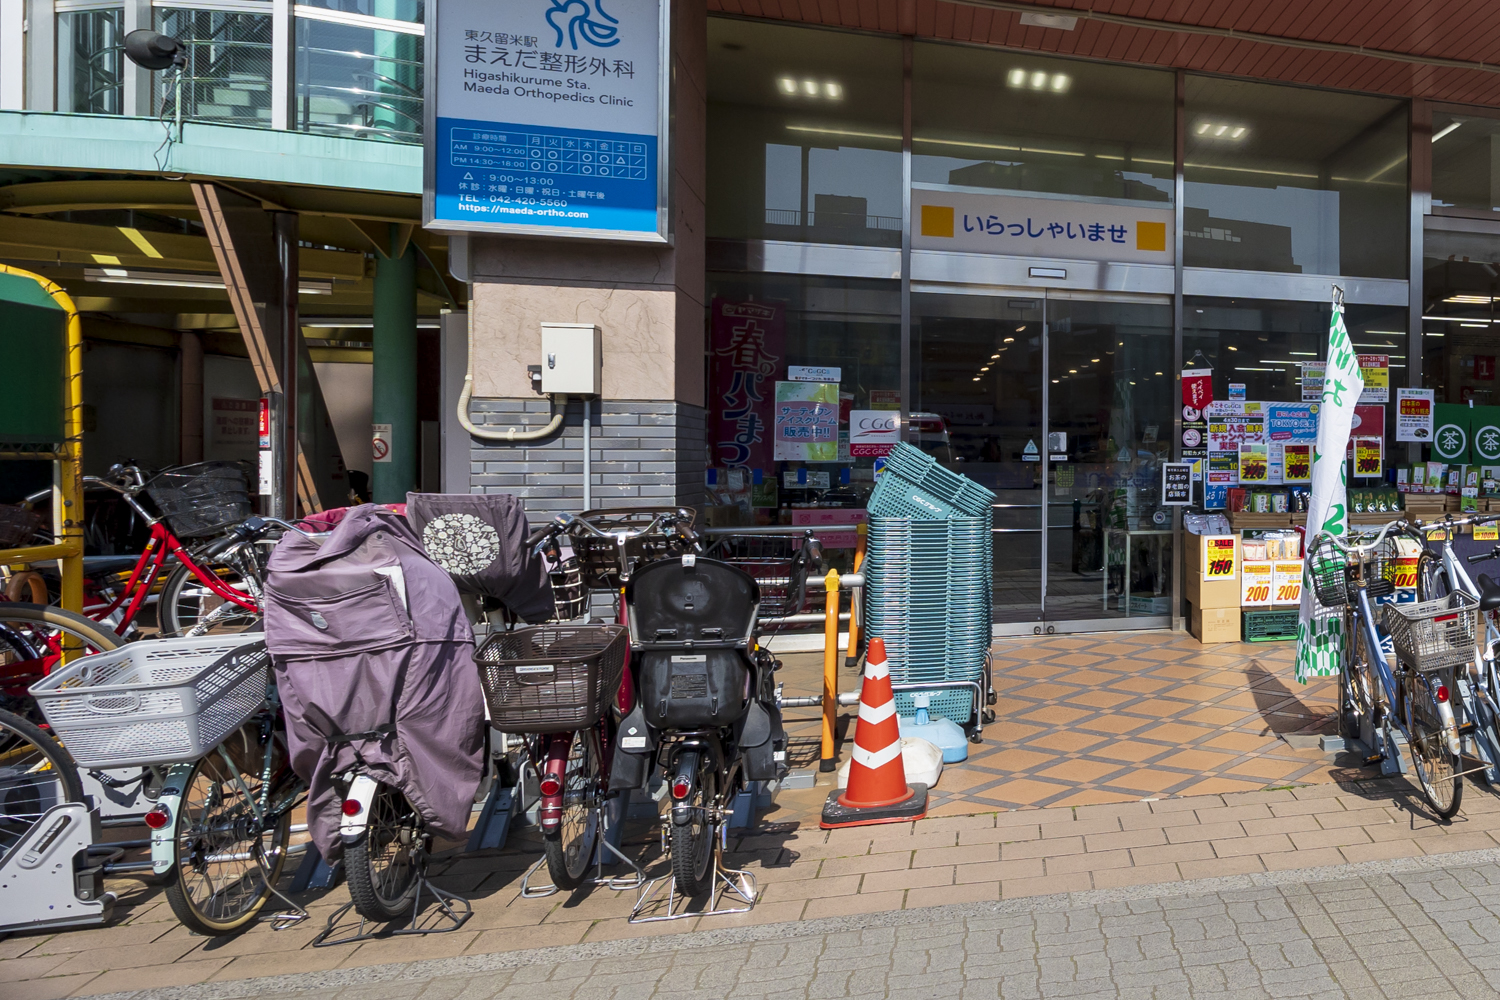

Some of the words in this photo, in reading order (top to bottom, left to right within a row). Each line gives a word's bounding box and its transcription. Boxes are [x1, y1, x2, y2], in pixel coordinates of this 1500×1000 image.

[465, 29, 538, 48] 東久留米駅
[464, 44, 635, 79] まえだ整形外科
[464, 68, 563, 88] Higashikurume
[566, 77, 591, 90] Sta.
[464, 82, 510, 95] Maeda
[514, 86, 595, 104] Orthopedics
[599, 95, 634, 107] Clinic
[473, 132, 507, 142] 診療時間
[531, 136, 541, 145] 月
[549, 138, 558, 147] 火
[566, 140, 575, 148] 水
[583, 141, 592, 149] 木
[600, 142, 609, 151] 金
[617, 144, 625, 152] 土
[634, 145, 641, 153] 日
[459, 194, 479, 202] TEL
[490, 195, 567, 207] 042-420-5560
[458, 203, 589, 219] https://maeda-ortho.com
[963, 214, 1128, 245] いらっしゃいませ
[1480, 360, 1489, 376] 1
[777, 415, 837, 425] アイスクリーム
[858, 418, 895, 431] CGC
[1441, 431, 1459, 450] 茶
[1483, 432, 1500, 451] 茶
[1209, 560, 1232, 575] 150
[1245, 586, 1269, 601] 200
[1277, 585, 1300, 601] 200
